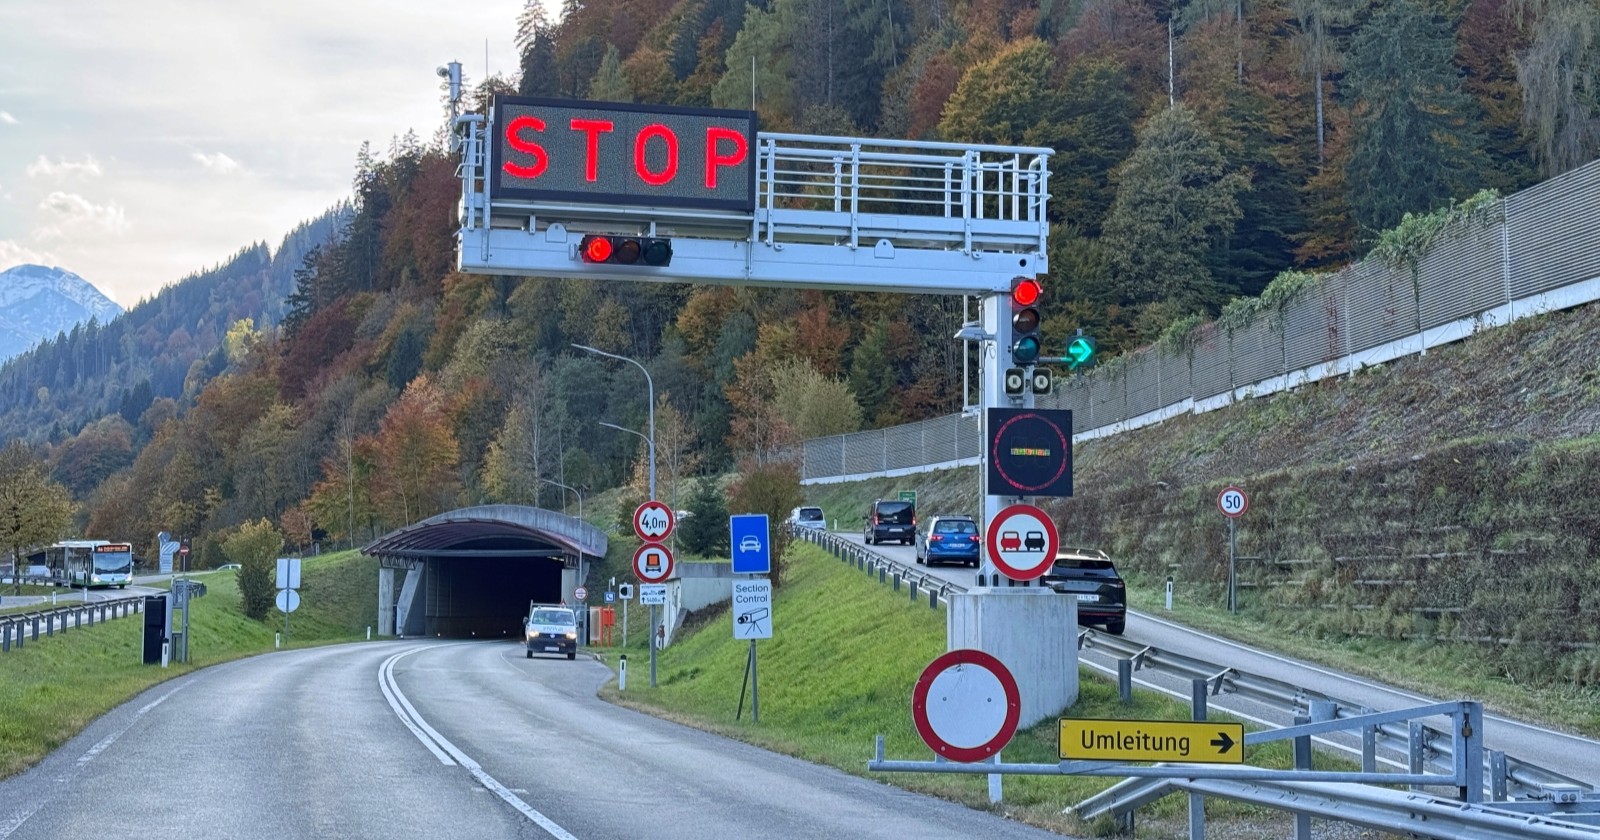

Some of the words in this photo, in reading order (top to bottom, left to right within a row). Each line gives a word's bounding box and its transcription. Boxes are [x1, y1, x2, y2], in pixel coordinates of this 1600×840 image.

[503, 115, 749, 189] STOP
[1225, 495, 1241, 509] 50
[641, 513, 667, 530] 4,0m
[735, 584, 769, 593] Section
[735, 594, 768, 603] Control
[1081, 730, 1190, 756] Umleitung
